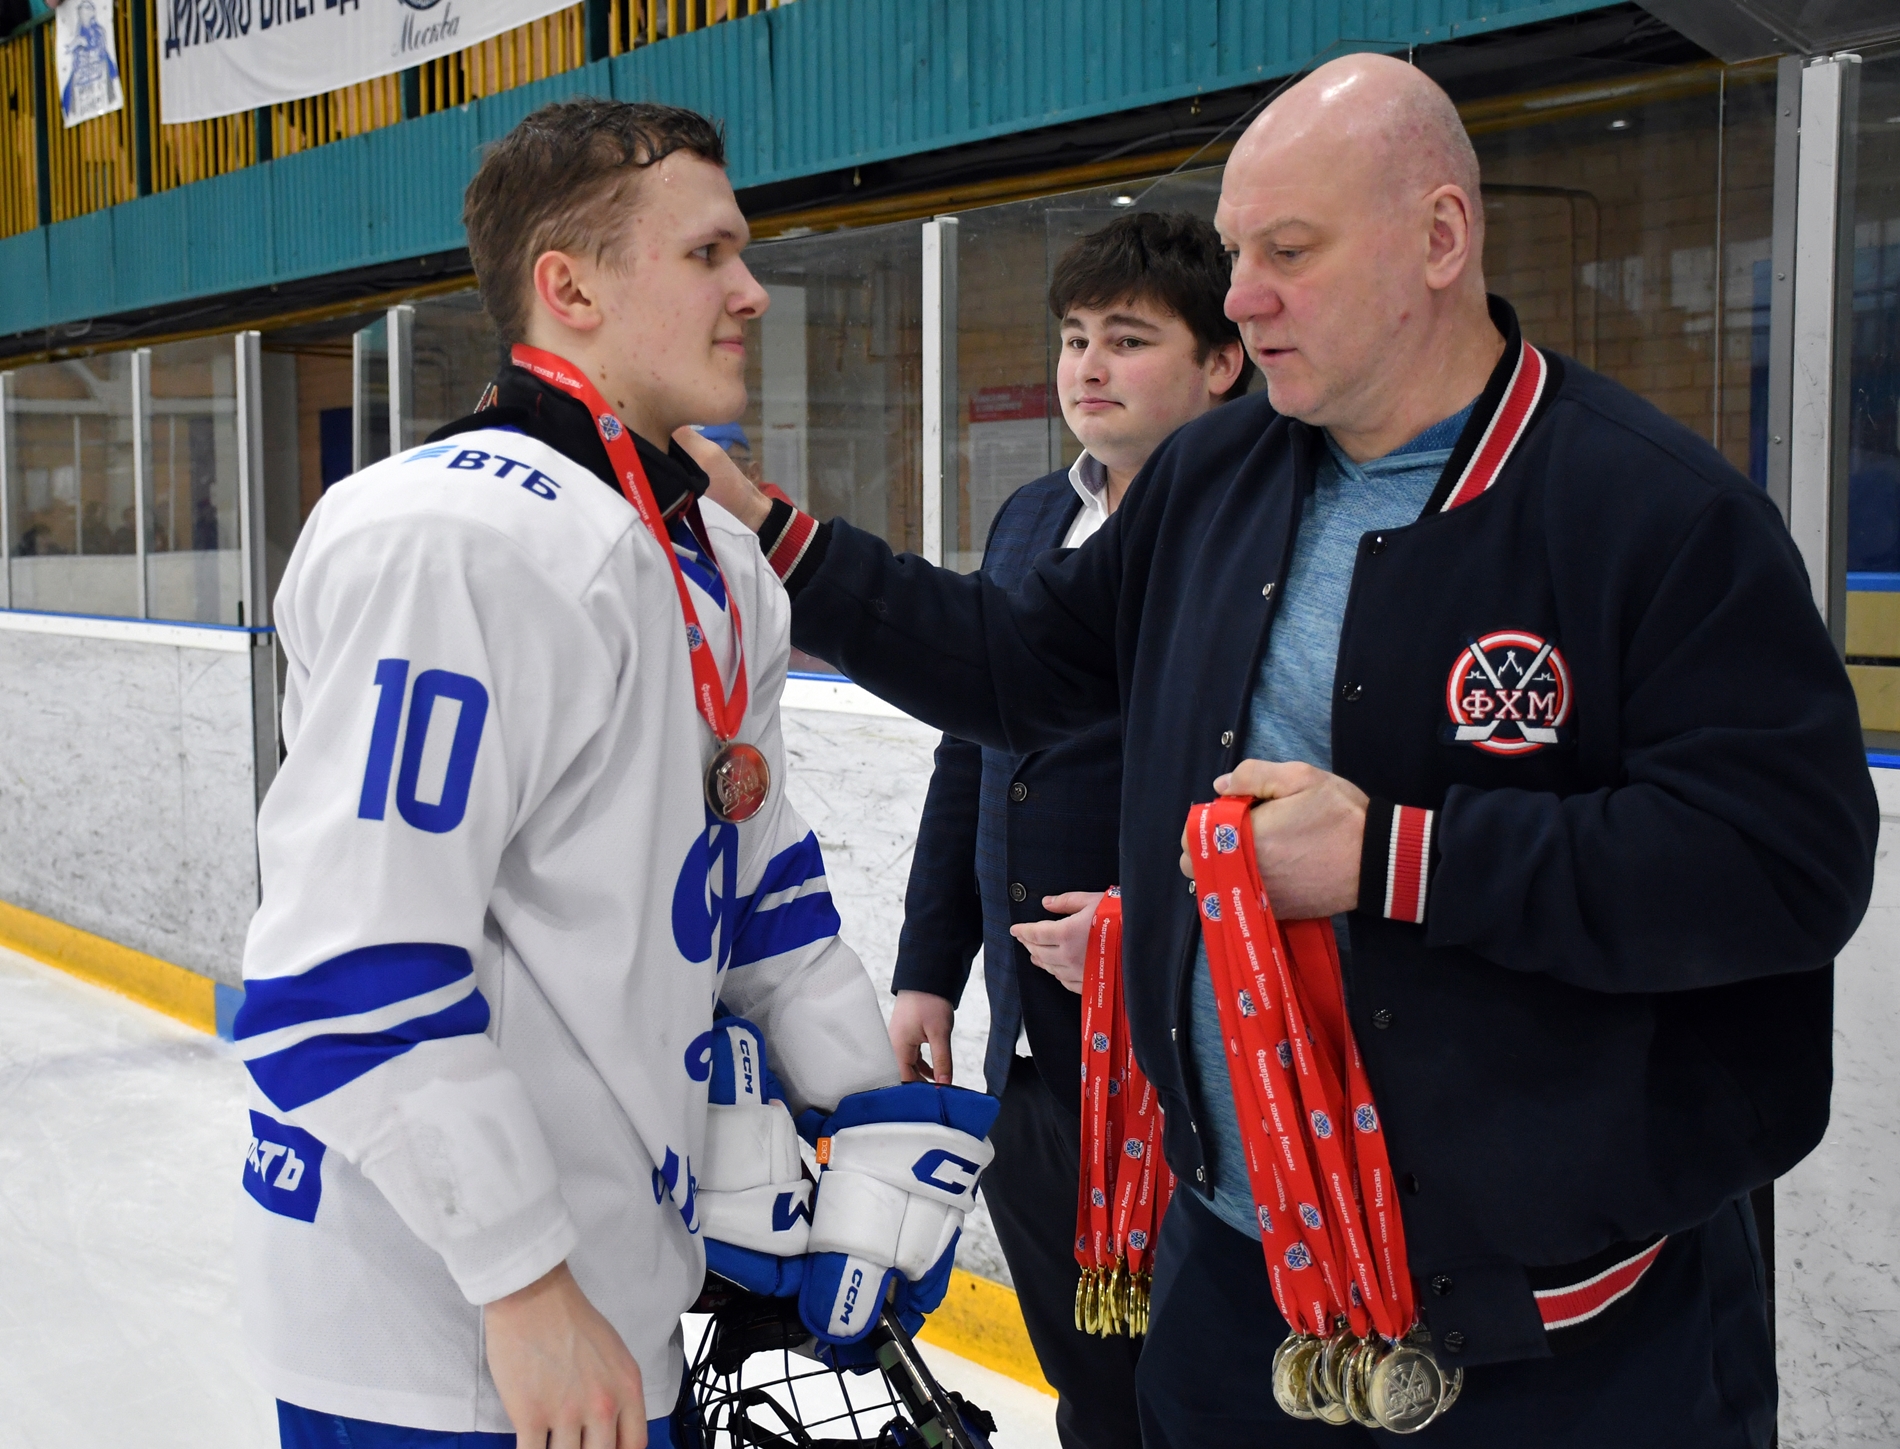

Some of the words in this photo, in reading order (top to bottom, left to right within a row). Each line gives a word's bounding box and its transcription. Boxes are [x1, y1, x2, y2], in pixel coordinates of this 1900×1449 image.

[447, 449, 562, 501] ВТБ
[626, 471, 650, 521] Федерация
[1462, 689, 1556, 720] ФХМ
[357, 658, 489, 834] 10
[1231, 886, 1250, 938] Федерация
[1245, 940, 1260, 971] хоккея
[1255, 972, 1272, 1010] Москвы
[739, 1038, 754, 1095] CCM
[1256, 1049, 1275, 1099] Федерация
[1270, 1102, 1284, 1132] хоккея
[1280, 1135, 1296, 1172] Москвы
[1373, 1168, 1384, 1208] Москвы
[1331, 1172, 1351, 1224] Федерация
[1347, 1227, 1361, 1259] хоккея
[1357, 1262, 1372, 1300] Москвы
[1378, 1211, 1388, 1244] хоккея
[839, 1267, 864, 1326] CCM
[1383, 1246, 1397, 1301] Федерация
[1312, 1300, 1326, 1336] Москвы
